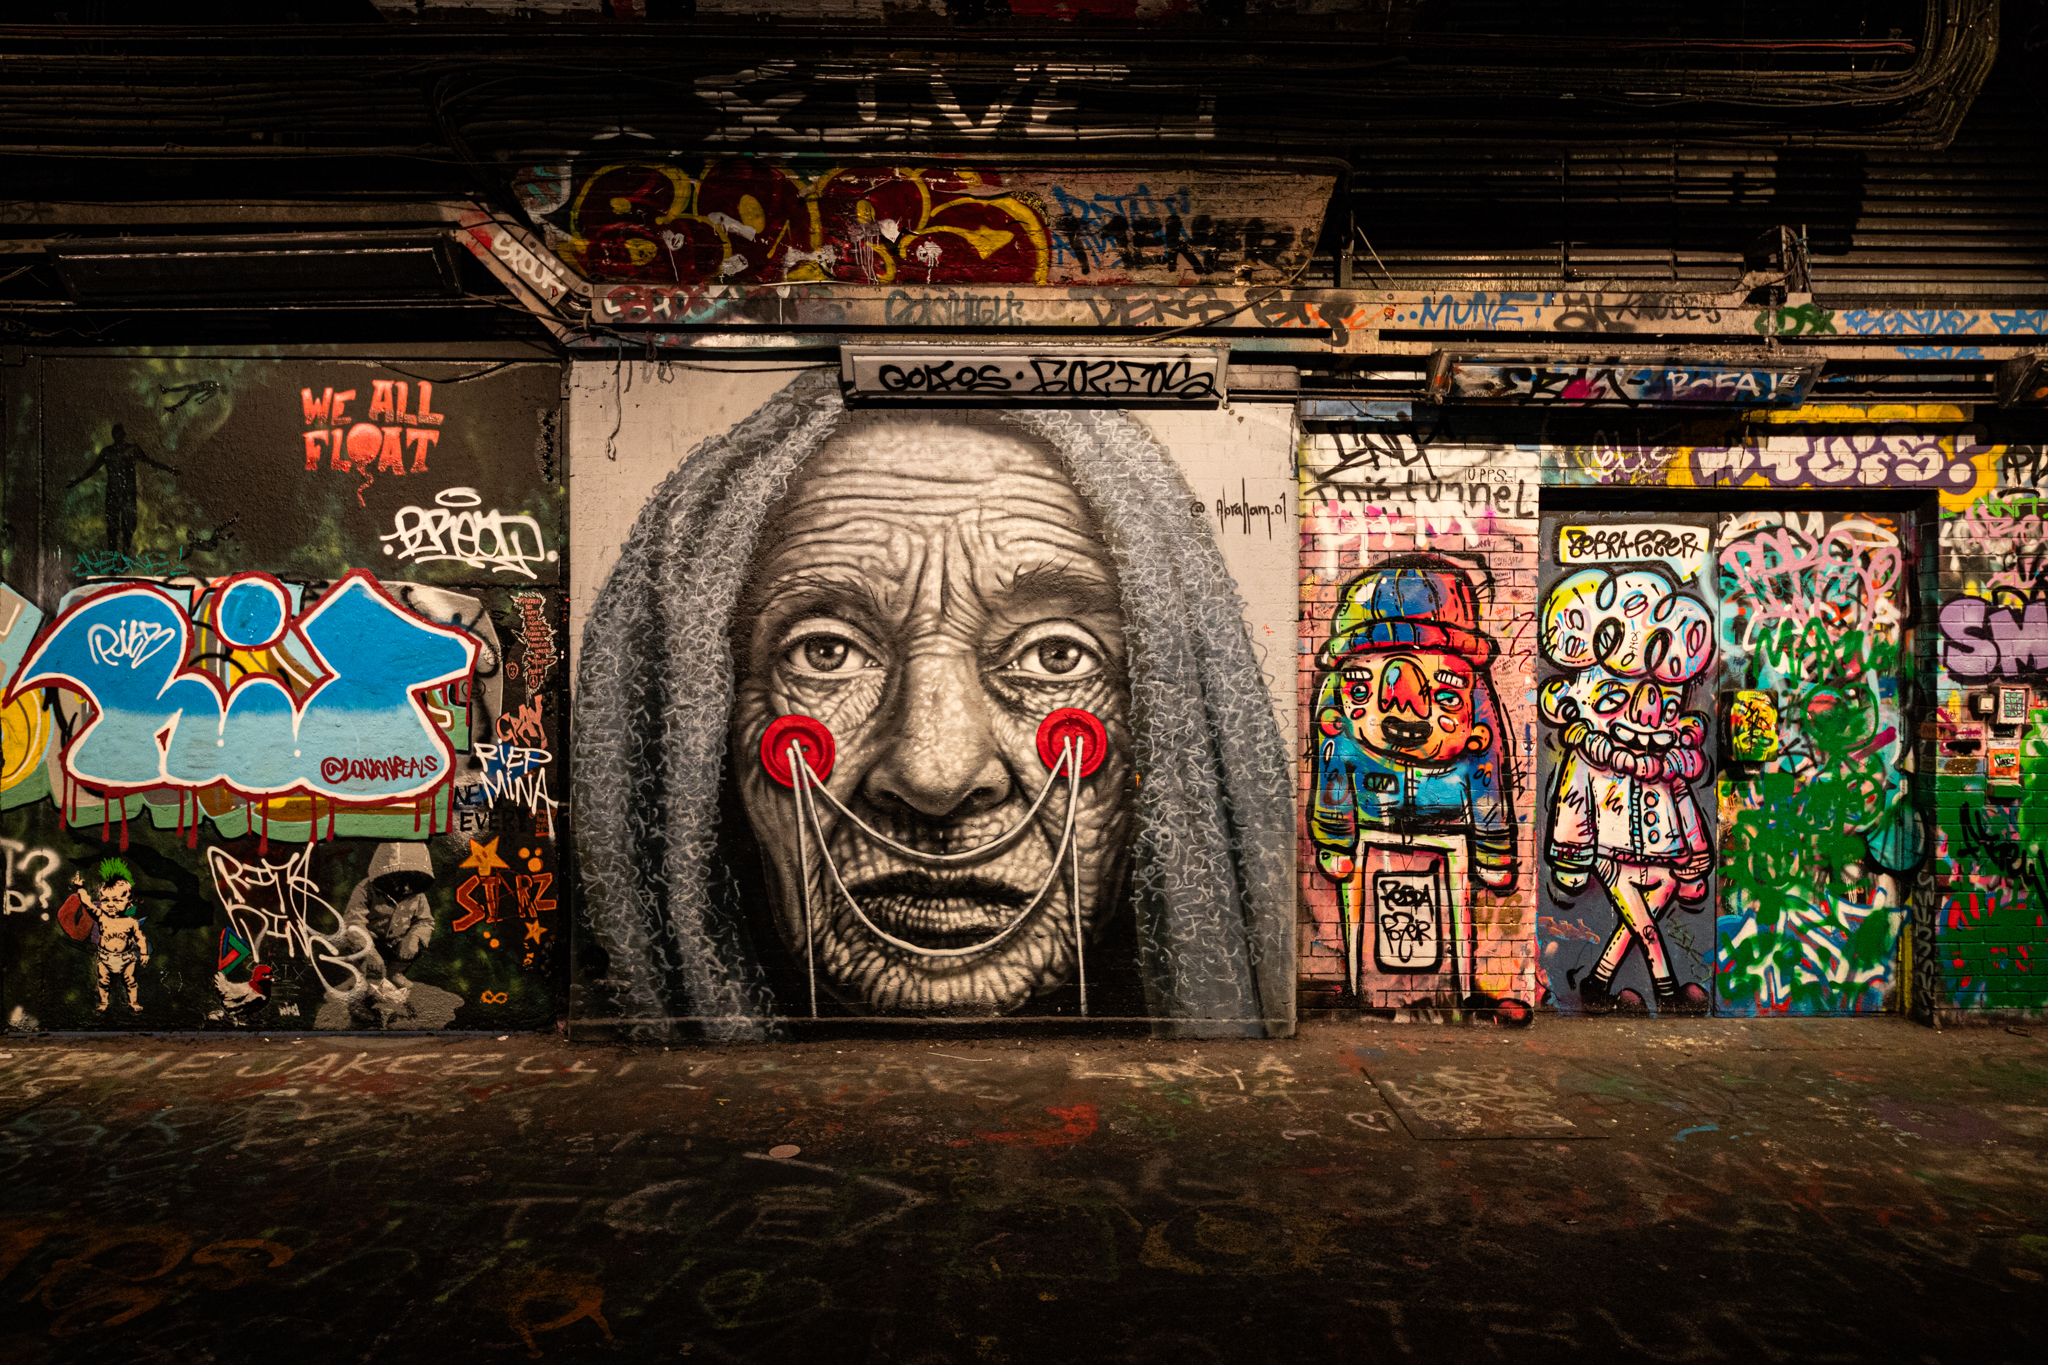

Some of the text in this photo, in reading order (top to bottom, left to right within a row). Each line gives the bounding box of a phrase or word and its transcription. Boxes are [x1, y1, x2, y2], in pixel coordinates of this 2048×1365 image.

[302, 379, 444, 425] WE ALL
[302, 423, 440, 479] FLOAT
